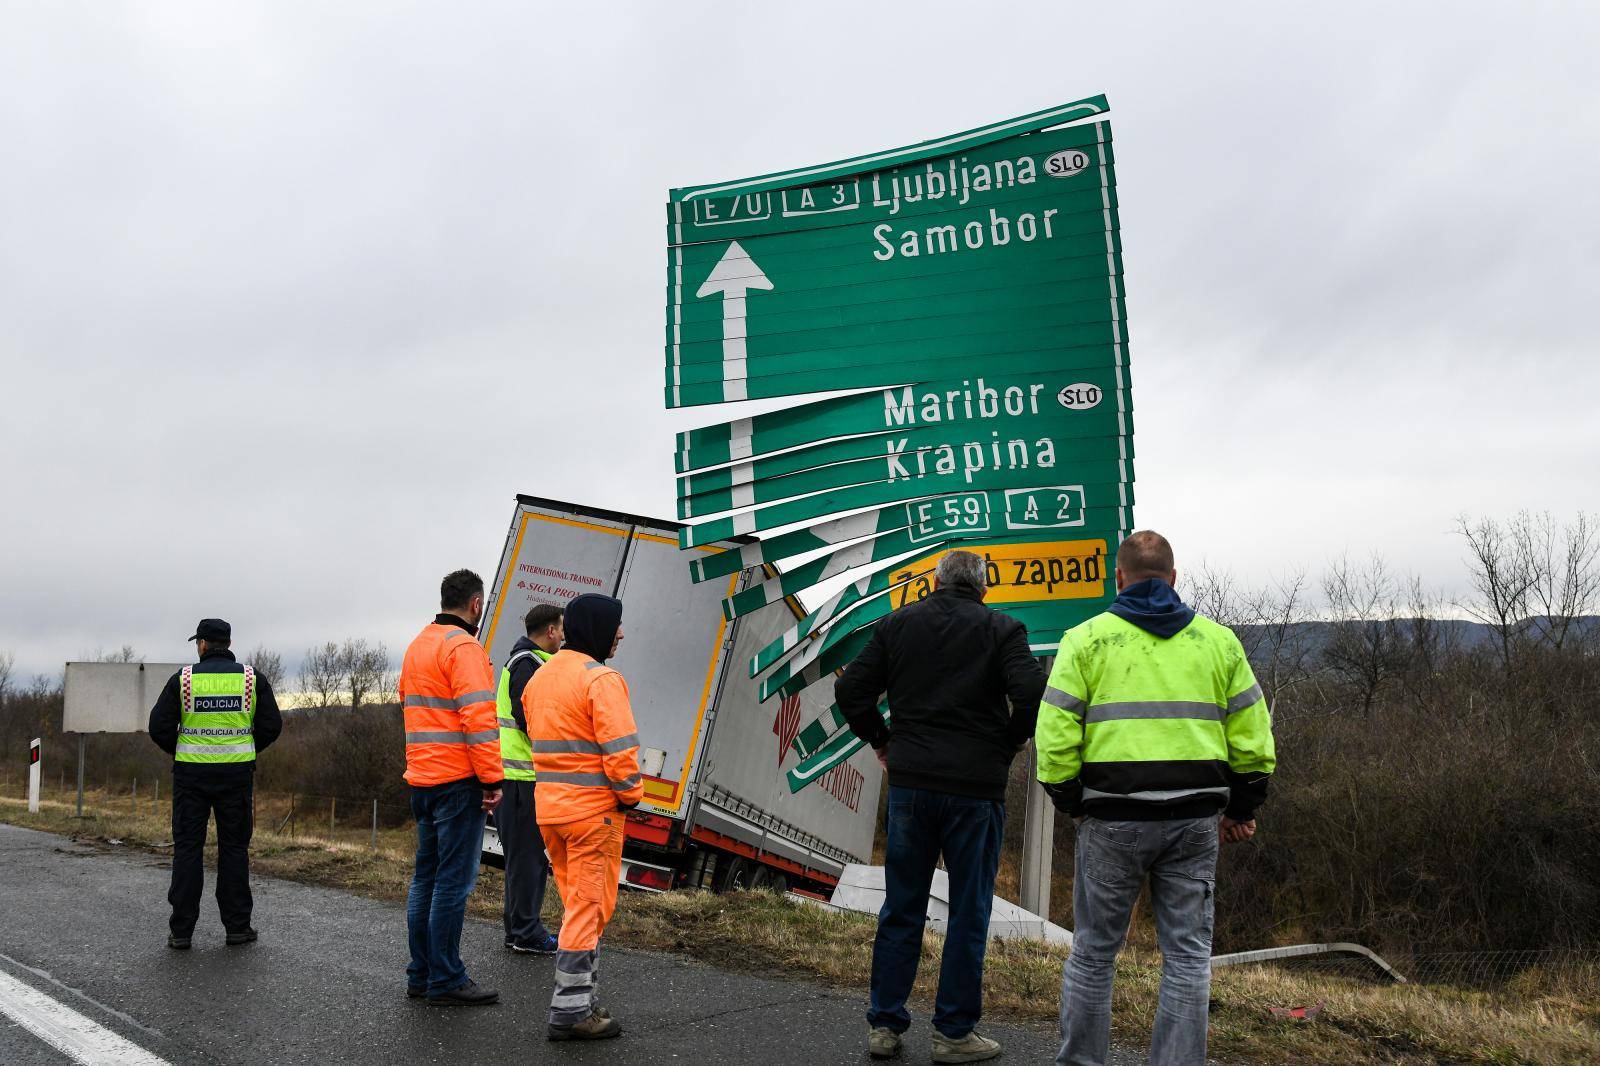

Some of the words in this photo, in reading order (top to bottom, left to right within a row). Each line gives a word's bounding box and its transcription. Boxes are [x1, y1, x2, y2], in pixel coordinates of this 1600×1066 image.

[1049, 154, 1084, 174] SLO
[800, 188, 815, 209] A
[831, 184, 845, 205] 3
[872, 156, 1036, 215] Ljubljana
[873, 208, 1058, 261] Samobor
[883, 378, 1044, 427] Maribor
[1063, 387, 1098, 405] SLO
[886, 431, 1056, 484] Krapina
[918, 503, 934, 534] E
[944, 496, 981, 527] 59
[1024, 495, 1039, 521] A
[1056, 493, 1070, 519] 2
[520, 564, 568, 579] INTERNATIONAL
[1012, 547, 1100, 594] zapad
[526, 582, 552, 595] SIGA
[196, 700, 239, 708] POLICIJA
[200, 728, 233, 736] POLICIJA
